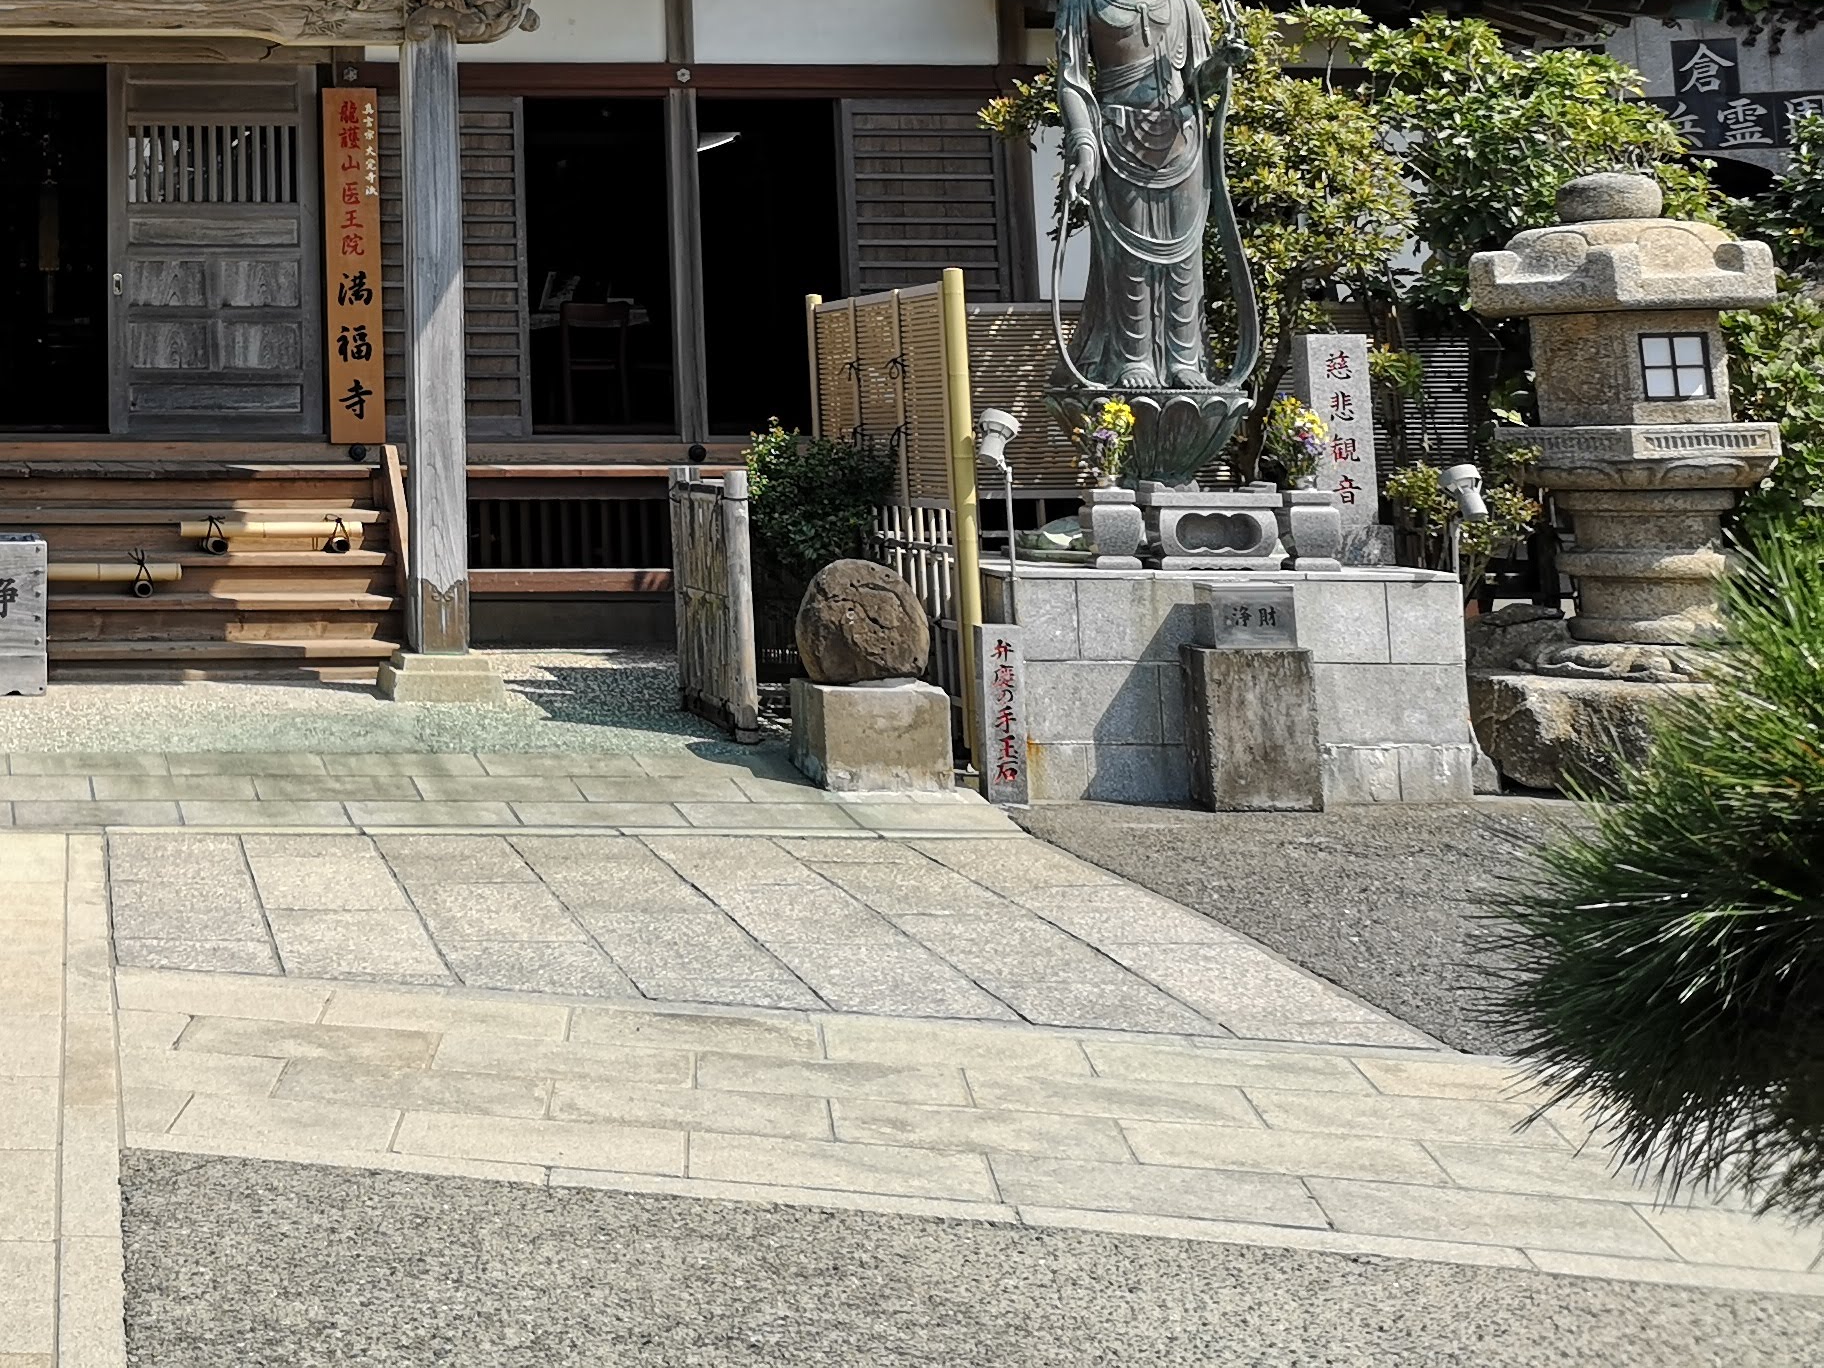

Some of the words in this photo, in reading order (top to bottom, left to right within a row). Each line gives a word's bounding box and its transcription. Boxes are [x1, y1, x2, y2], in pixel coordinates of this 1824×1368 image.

[1678, 42, 1736, 94] 倉
[339, 100, 365, 256] 龍護山医王院
[336, 270, 374, 421] 満福寺
[1326, 349, 1362, 506] 慈悲観音
[1232, 605, 1276, 627] 浄財
[990, 638, 1019, 786] 弁慶の手玉石
